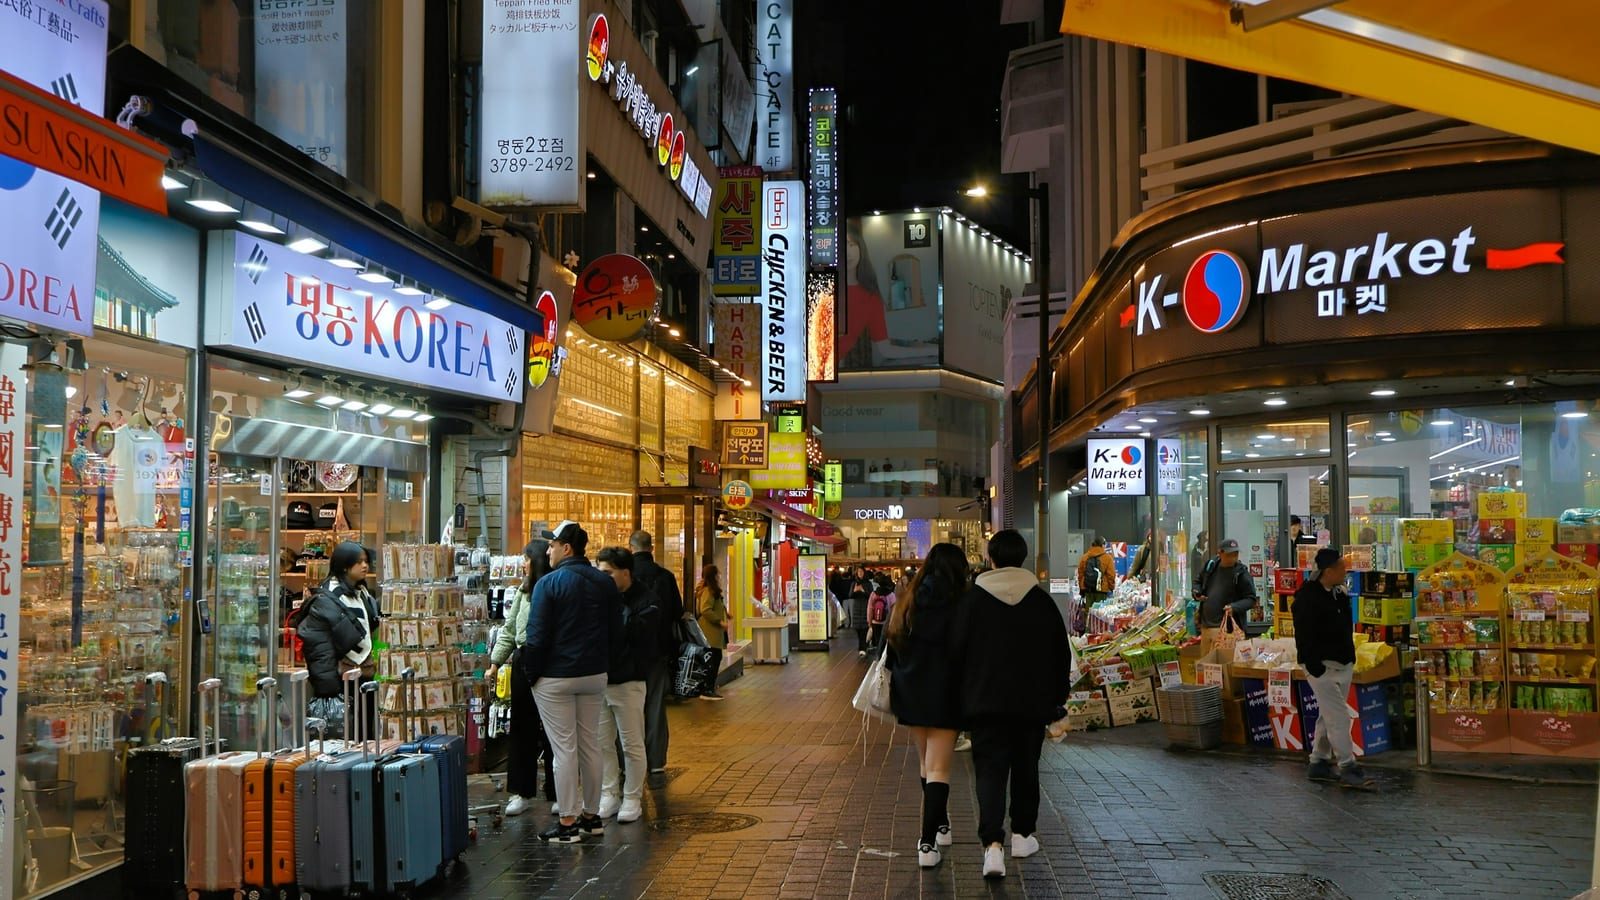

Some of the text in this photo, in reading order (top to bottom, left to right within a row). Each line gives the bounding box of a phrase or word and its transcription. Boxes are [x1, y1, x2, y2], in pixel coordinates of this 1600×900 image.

[3, 104, 127, 187] SUNSKIN
[497, 136, 564, 155] 명동2호점
[489, 156, 574, 173] 3789-2492
[766, 156, 781, 168] 4F
[720, 181, 756, 251] 사주
[816, 238, 833, 250] 3F
[1257, 226, 1477, 295] Market
[717, 259, 758, 282] 타로
[731, 308, 745, 415] HARUKI
[727, 438, 763, 453] 전당포
[1091, 467, 1143, 479] Market
